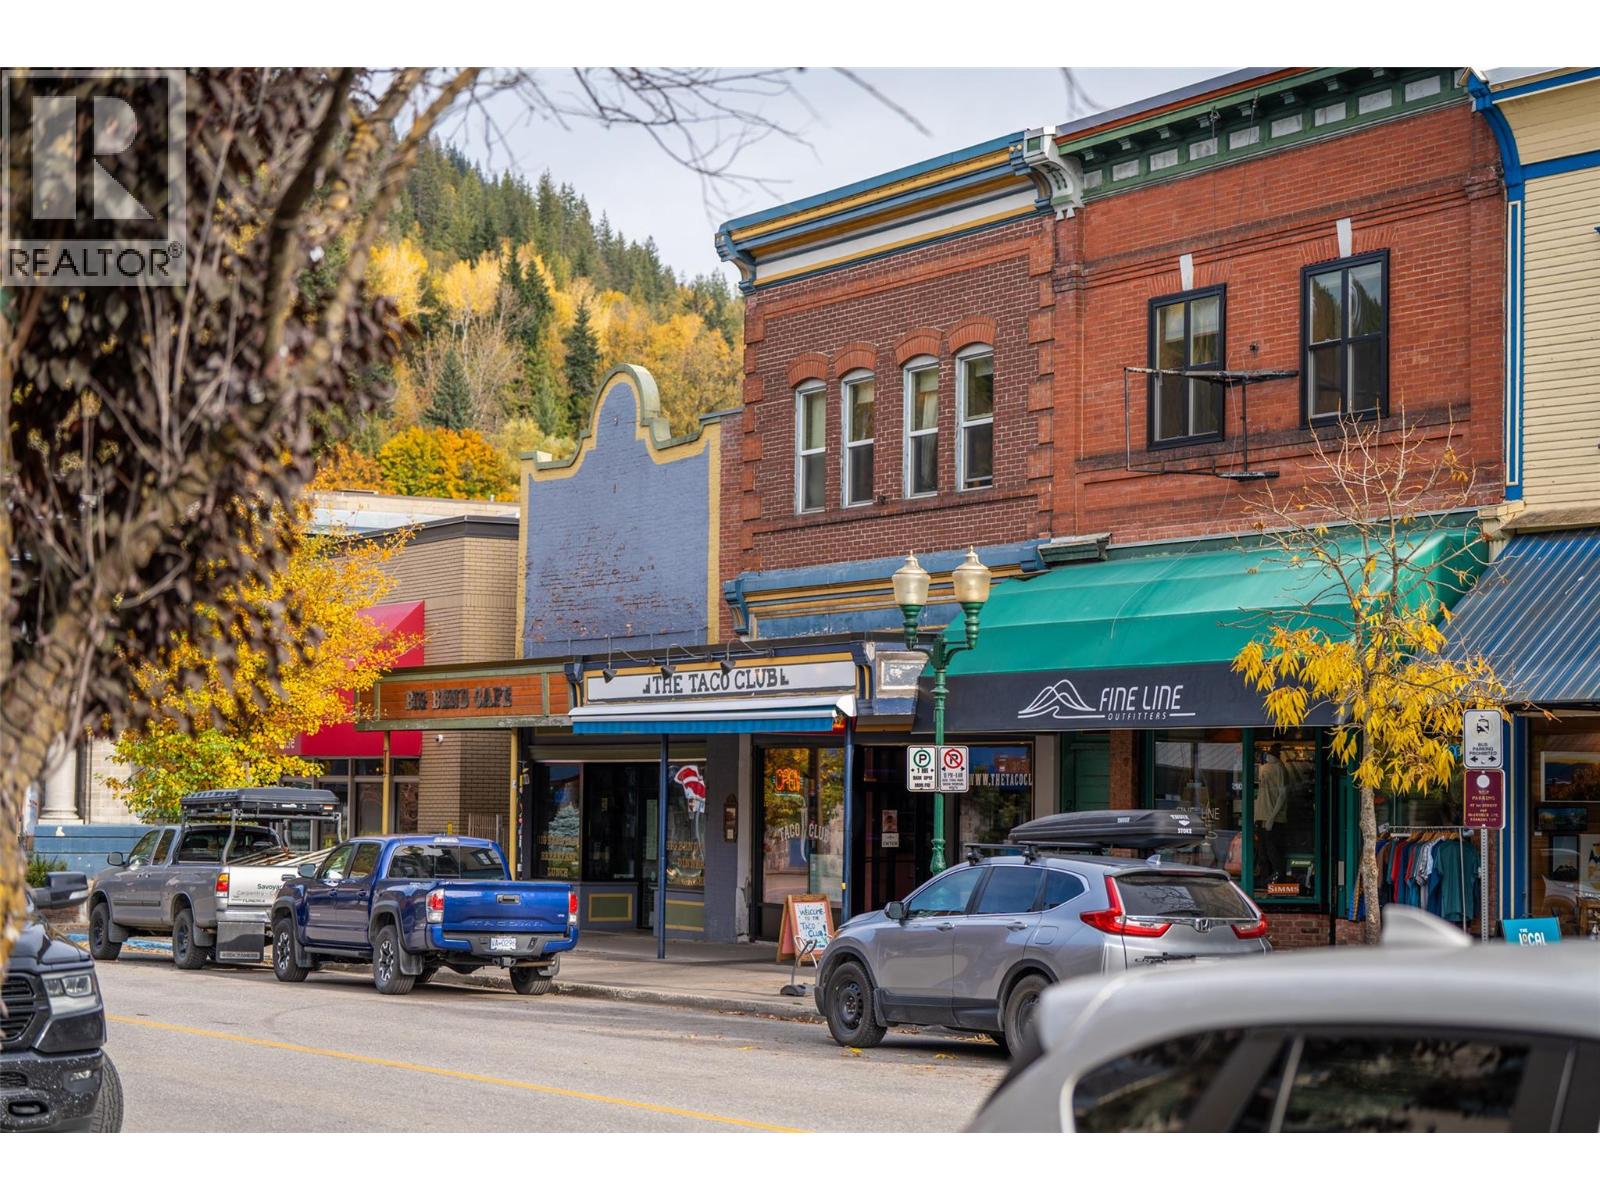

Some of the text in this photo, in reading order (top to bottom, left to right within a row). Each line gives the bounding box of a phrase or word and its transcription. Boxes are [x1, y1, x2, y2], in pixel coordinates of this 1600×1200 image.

[652, 668, 778, 694] THE TACO CLUB
[1099, 684, 1184, 711] FINE LINE
[1107, 711, 1167, 721] OUTFITTERS
[778, 823, 800, 840] TACO
[1267, 884, 1300, 893] SIMMS
